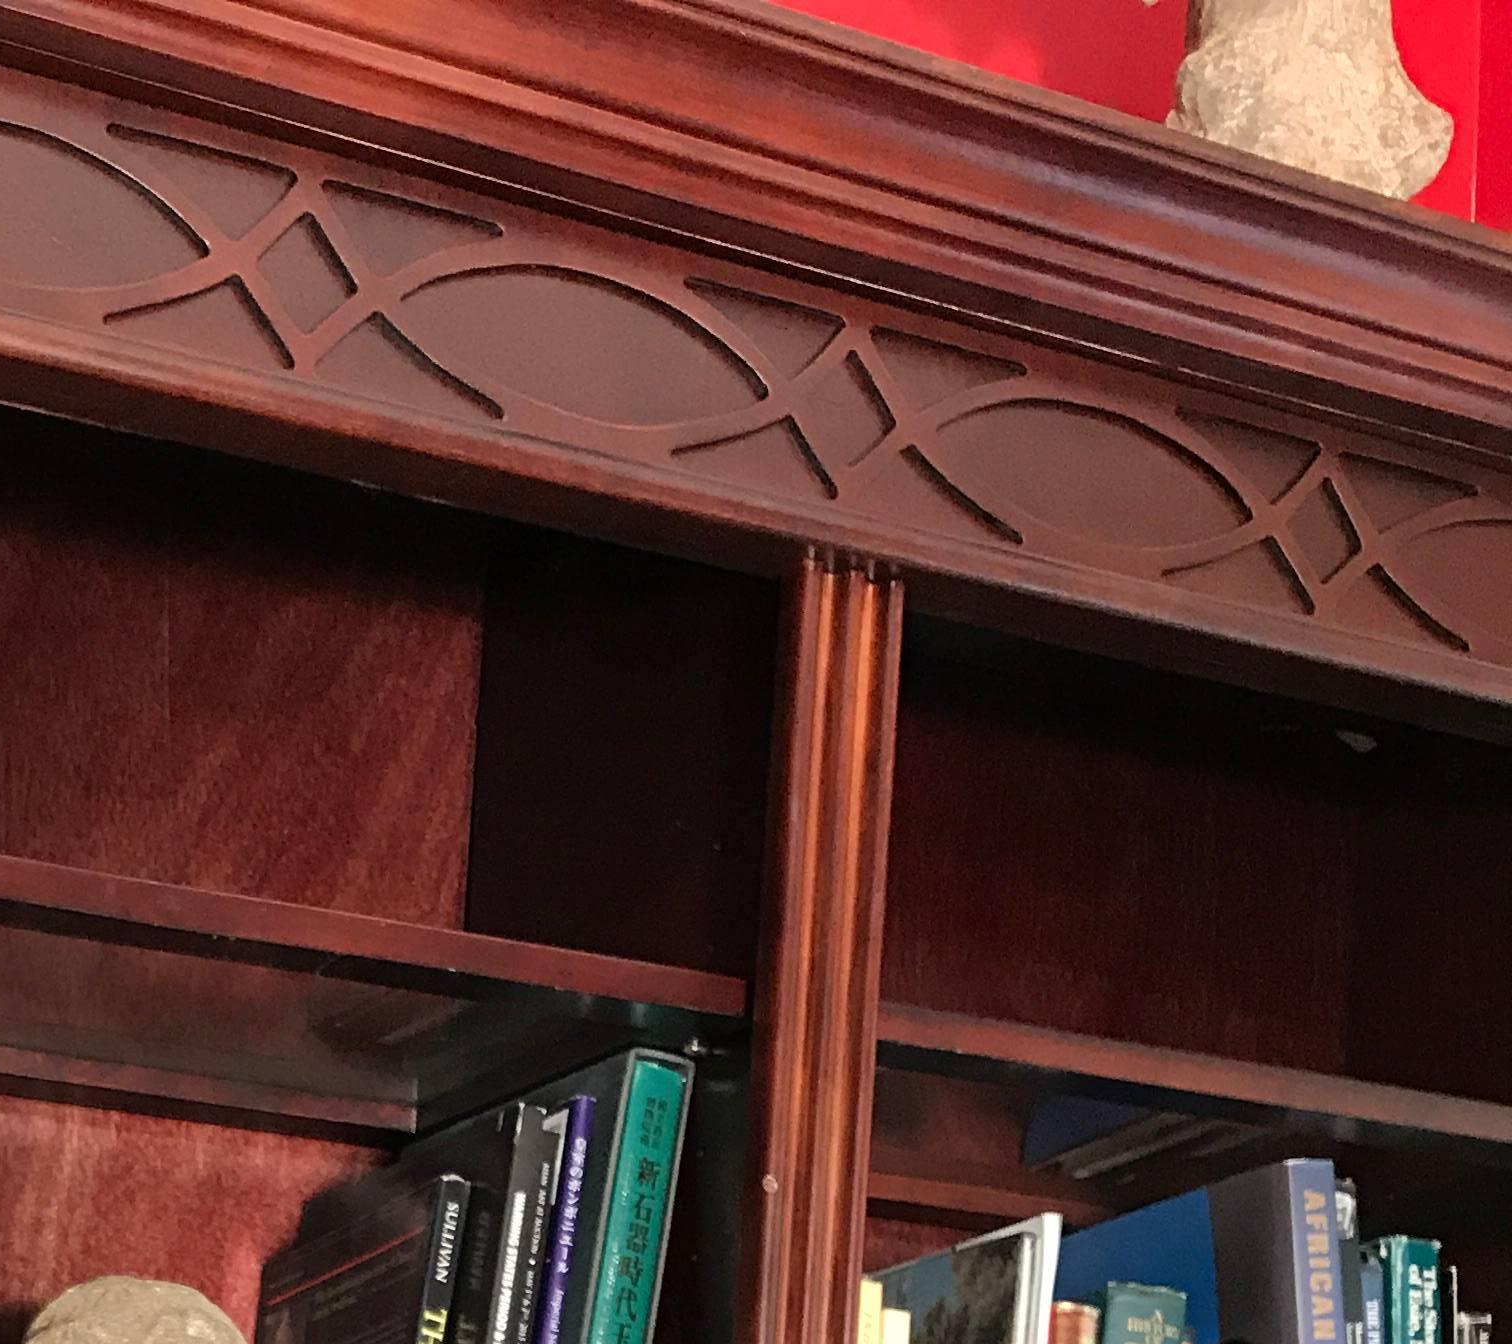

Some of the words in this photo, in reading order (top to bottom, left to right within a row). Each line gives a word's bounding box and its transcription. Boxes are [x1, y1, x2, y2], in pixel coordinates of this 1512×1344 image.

[506, 1191, 526, 1247] WARRING
[433, 1200, 461, 1284] SULLIVAN
[500, 1246, 518, 1287] STATES
[1302, 1189, 1335, 1341] AFRICAN
[1408, 1262, 1424, 1284] of
[1422, 1264, 1438, 1308] The
[493, 1286, 512, 1332] PERIOD
[547, 1288, 565, 1332] Imperial
[491, 1330, 505, 1342] &
